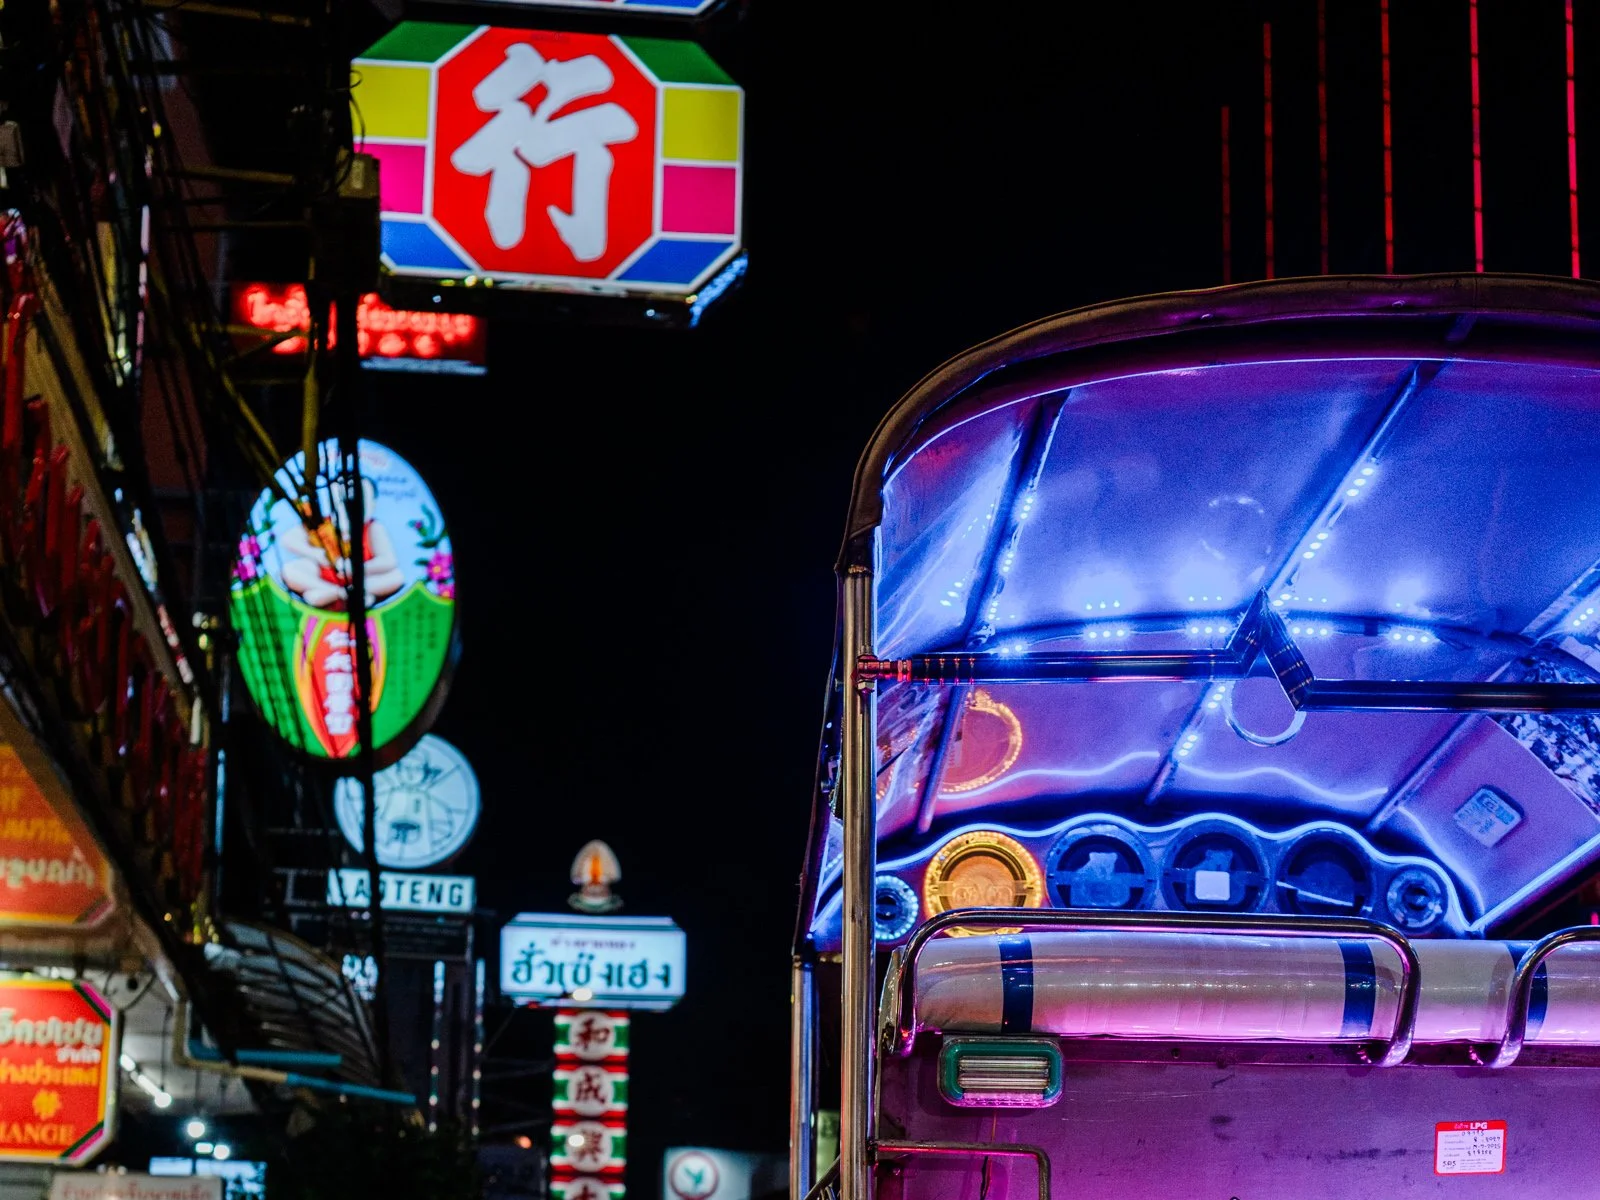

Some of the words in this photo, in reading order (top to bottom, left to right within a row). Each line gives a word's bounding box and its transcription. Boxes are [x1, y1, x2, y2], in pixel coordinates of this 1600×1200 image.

[451, 42, 639, 263] 行
[339, 877, 464, 907] ATENG
[1470, 1122, 1488, 1130] LPG
